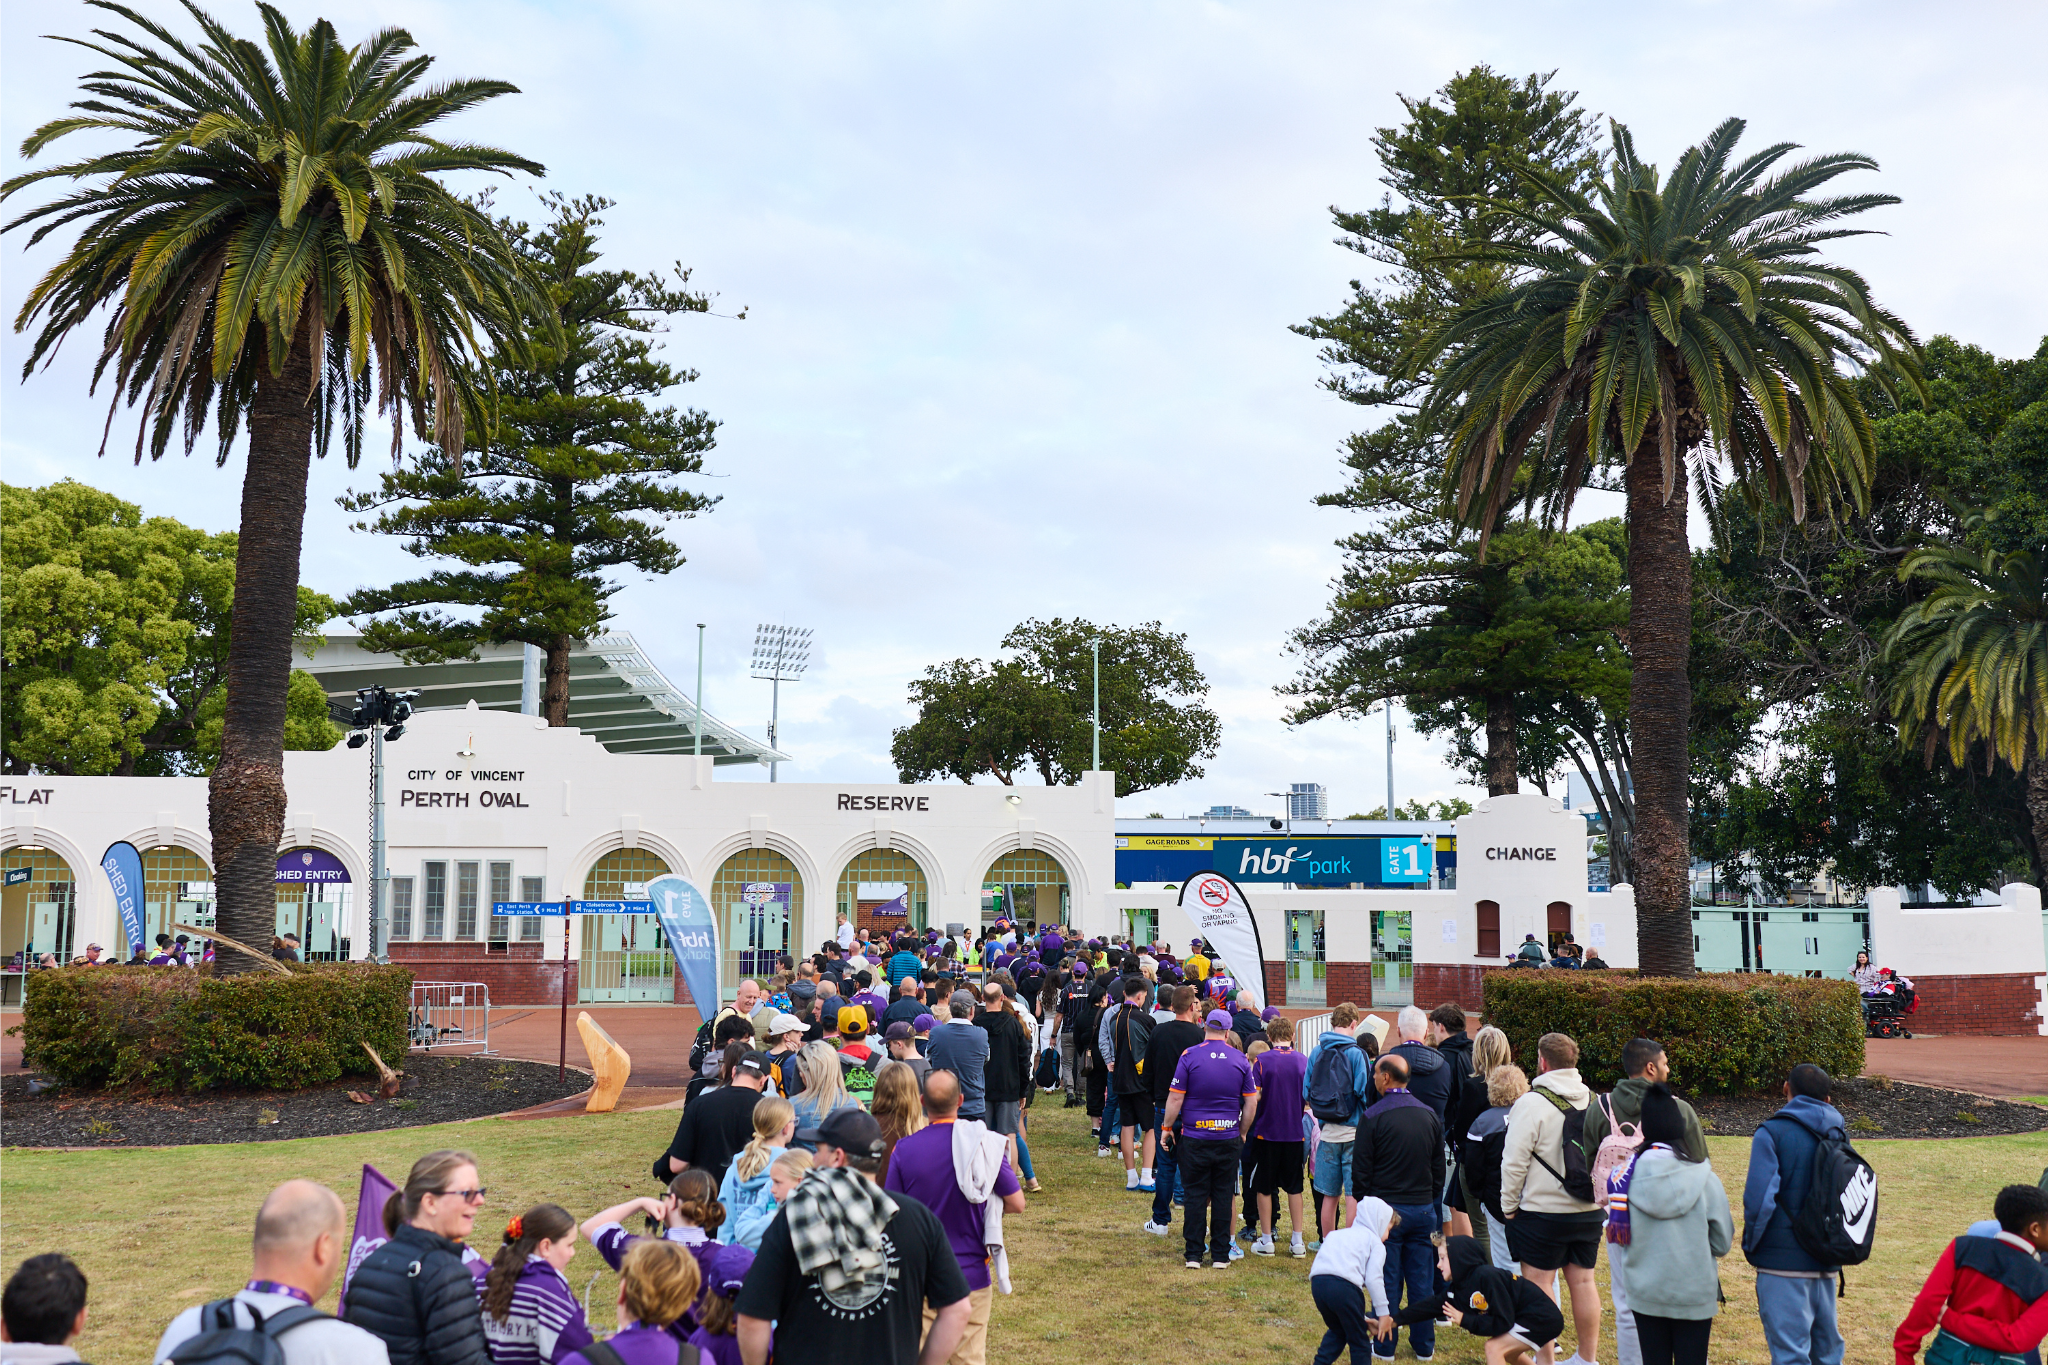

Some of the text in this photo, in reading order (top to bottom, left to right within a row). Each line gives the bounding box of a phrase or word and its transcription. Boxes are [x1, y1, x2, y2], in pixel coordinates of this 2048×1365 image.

[408, 770, 525, 781] CITY OF VINCENT
[0, 786, 54, 804] FLAT
[400, 789, 529, 808] PERTH OVAL
[837, 793, 929, 811] RESERVE
[1239, 846, 1351, 879] hbf park
[1389, 844, 1423, 876] GATE 1
[1485, 847, 1556, 861] CHANGE
[275, 870, 343, 880] SHED ENTRY
[104, 858, 142, 947] SHED ENTRY
[1202, 912, 1235, 921] SMOKING
[1213, 919, 1238, 927] VAPING
[1195, 1119, 1238, 1129] SUBWAY
[1840, 1164, 1870, 1223] NIKE
[814, 1295, 890, 1321] AUSTRALIA
